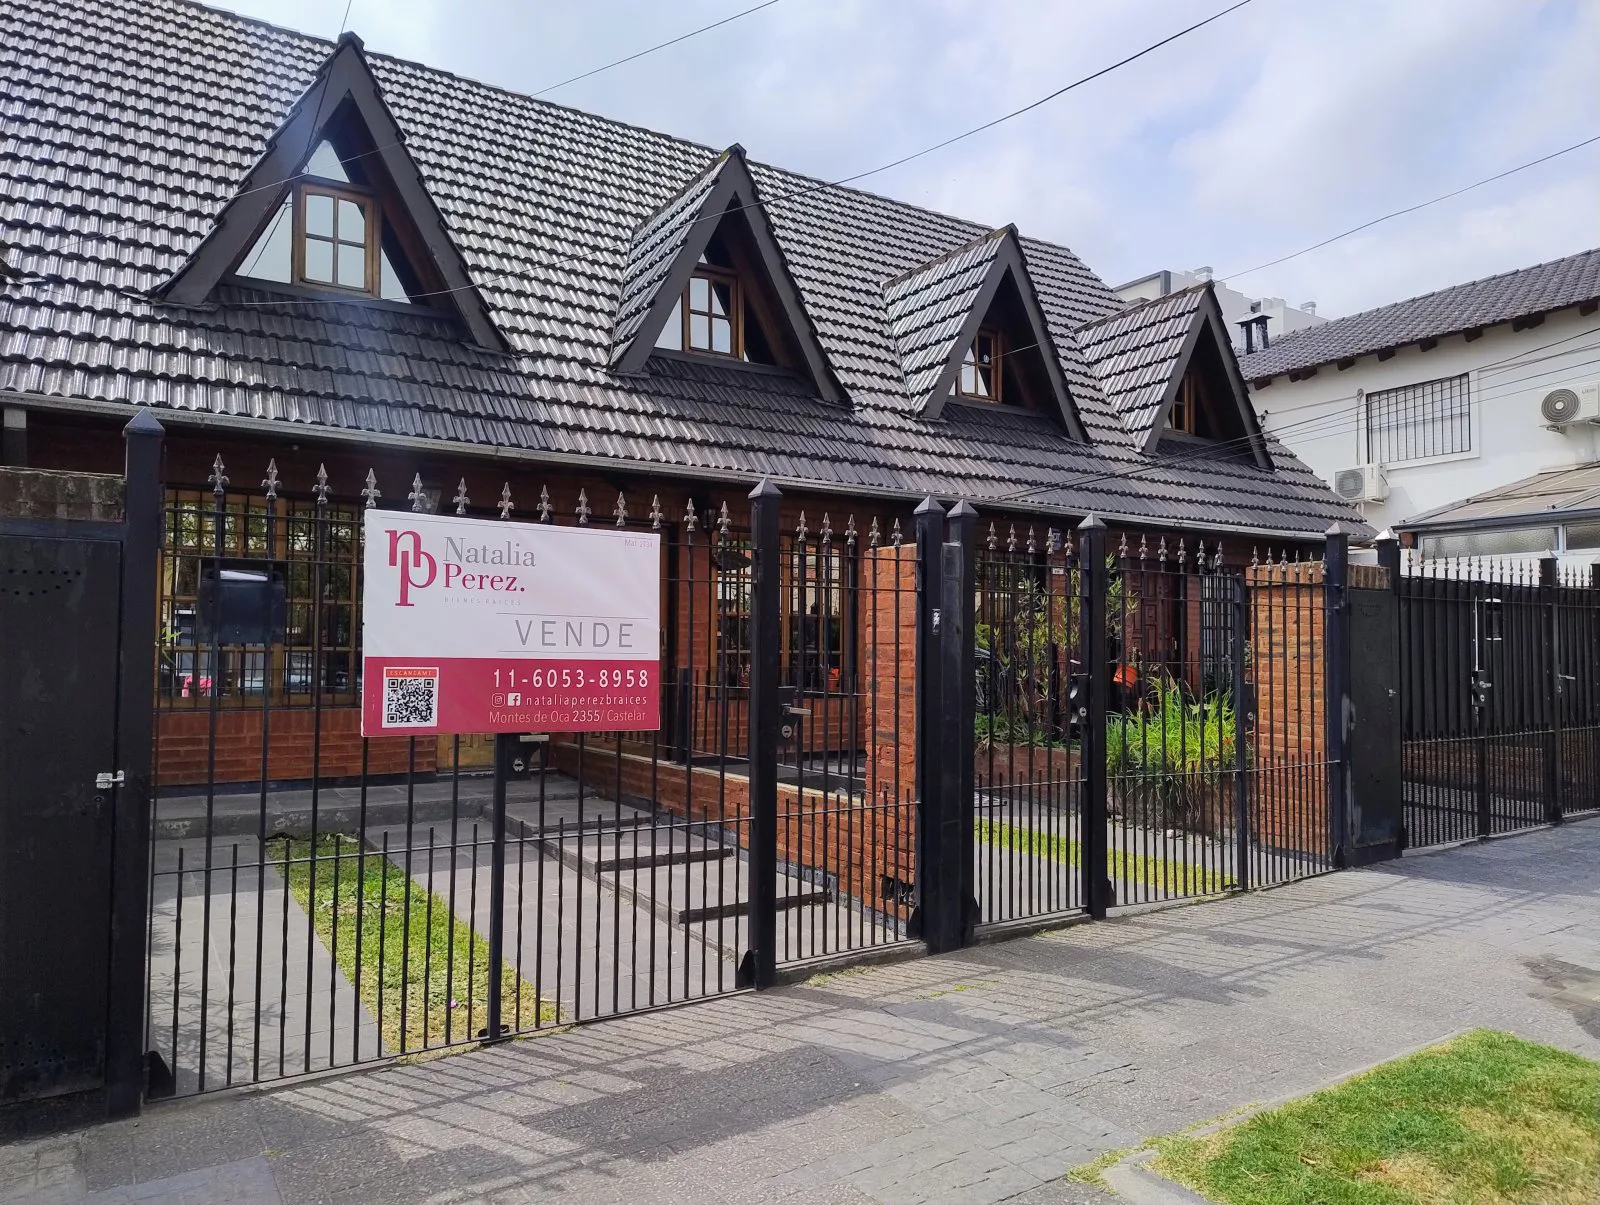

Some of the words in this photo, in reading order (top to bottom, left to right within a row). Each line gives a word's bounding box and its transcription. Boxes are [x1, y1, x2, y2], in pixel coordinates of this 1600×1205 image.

[443, 536, 536, 567] Natalia
[443, 563, 525, 592] Perez.
[515, 619, 633, 648] VENDE
[494, 668, 648, 688] 11-6053-8958
[526, 693, 647, 708] nataliaperezbraices
[489, 711, 531, 724] Montes
[534, 710, 548, 723] de
[550, 710, 570, 722] Oca
[607, 709, 646, 722] Castelar
